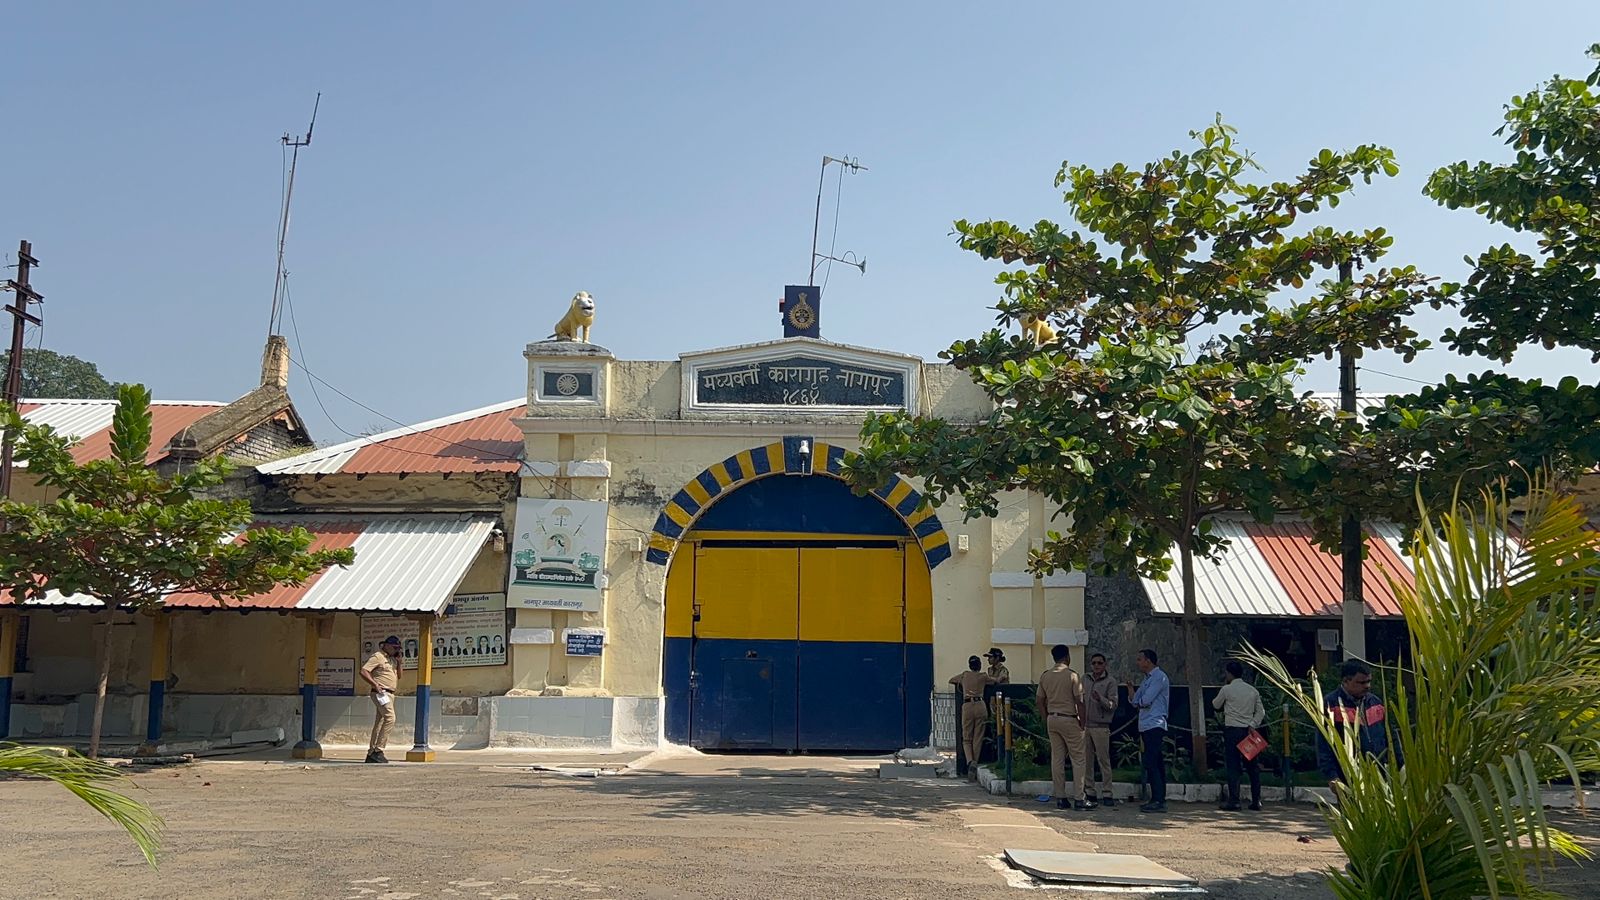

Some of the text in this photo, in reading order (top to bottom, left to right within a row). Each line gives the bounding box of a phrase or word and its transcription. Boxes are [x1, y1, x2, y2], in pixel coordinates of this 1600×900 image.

[768, 366, 831, 391] कारागृह
[835, 369, 894, 397] नागपूर
[783, 388, 820, 406] १८६४
